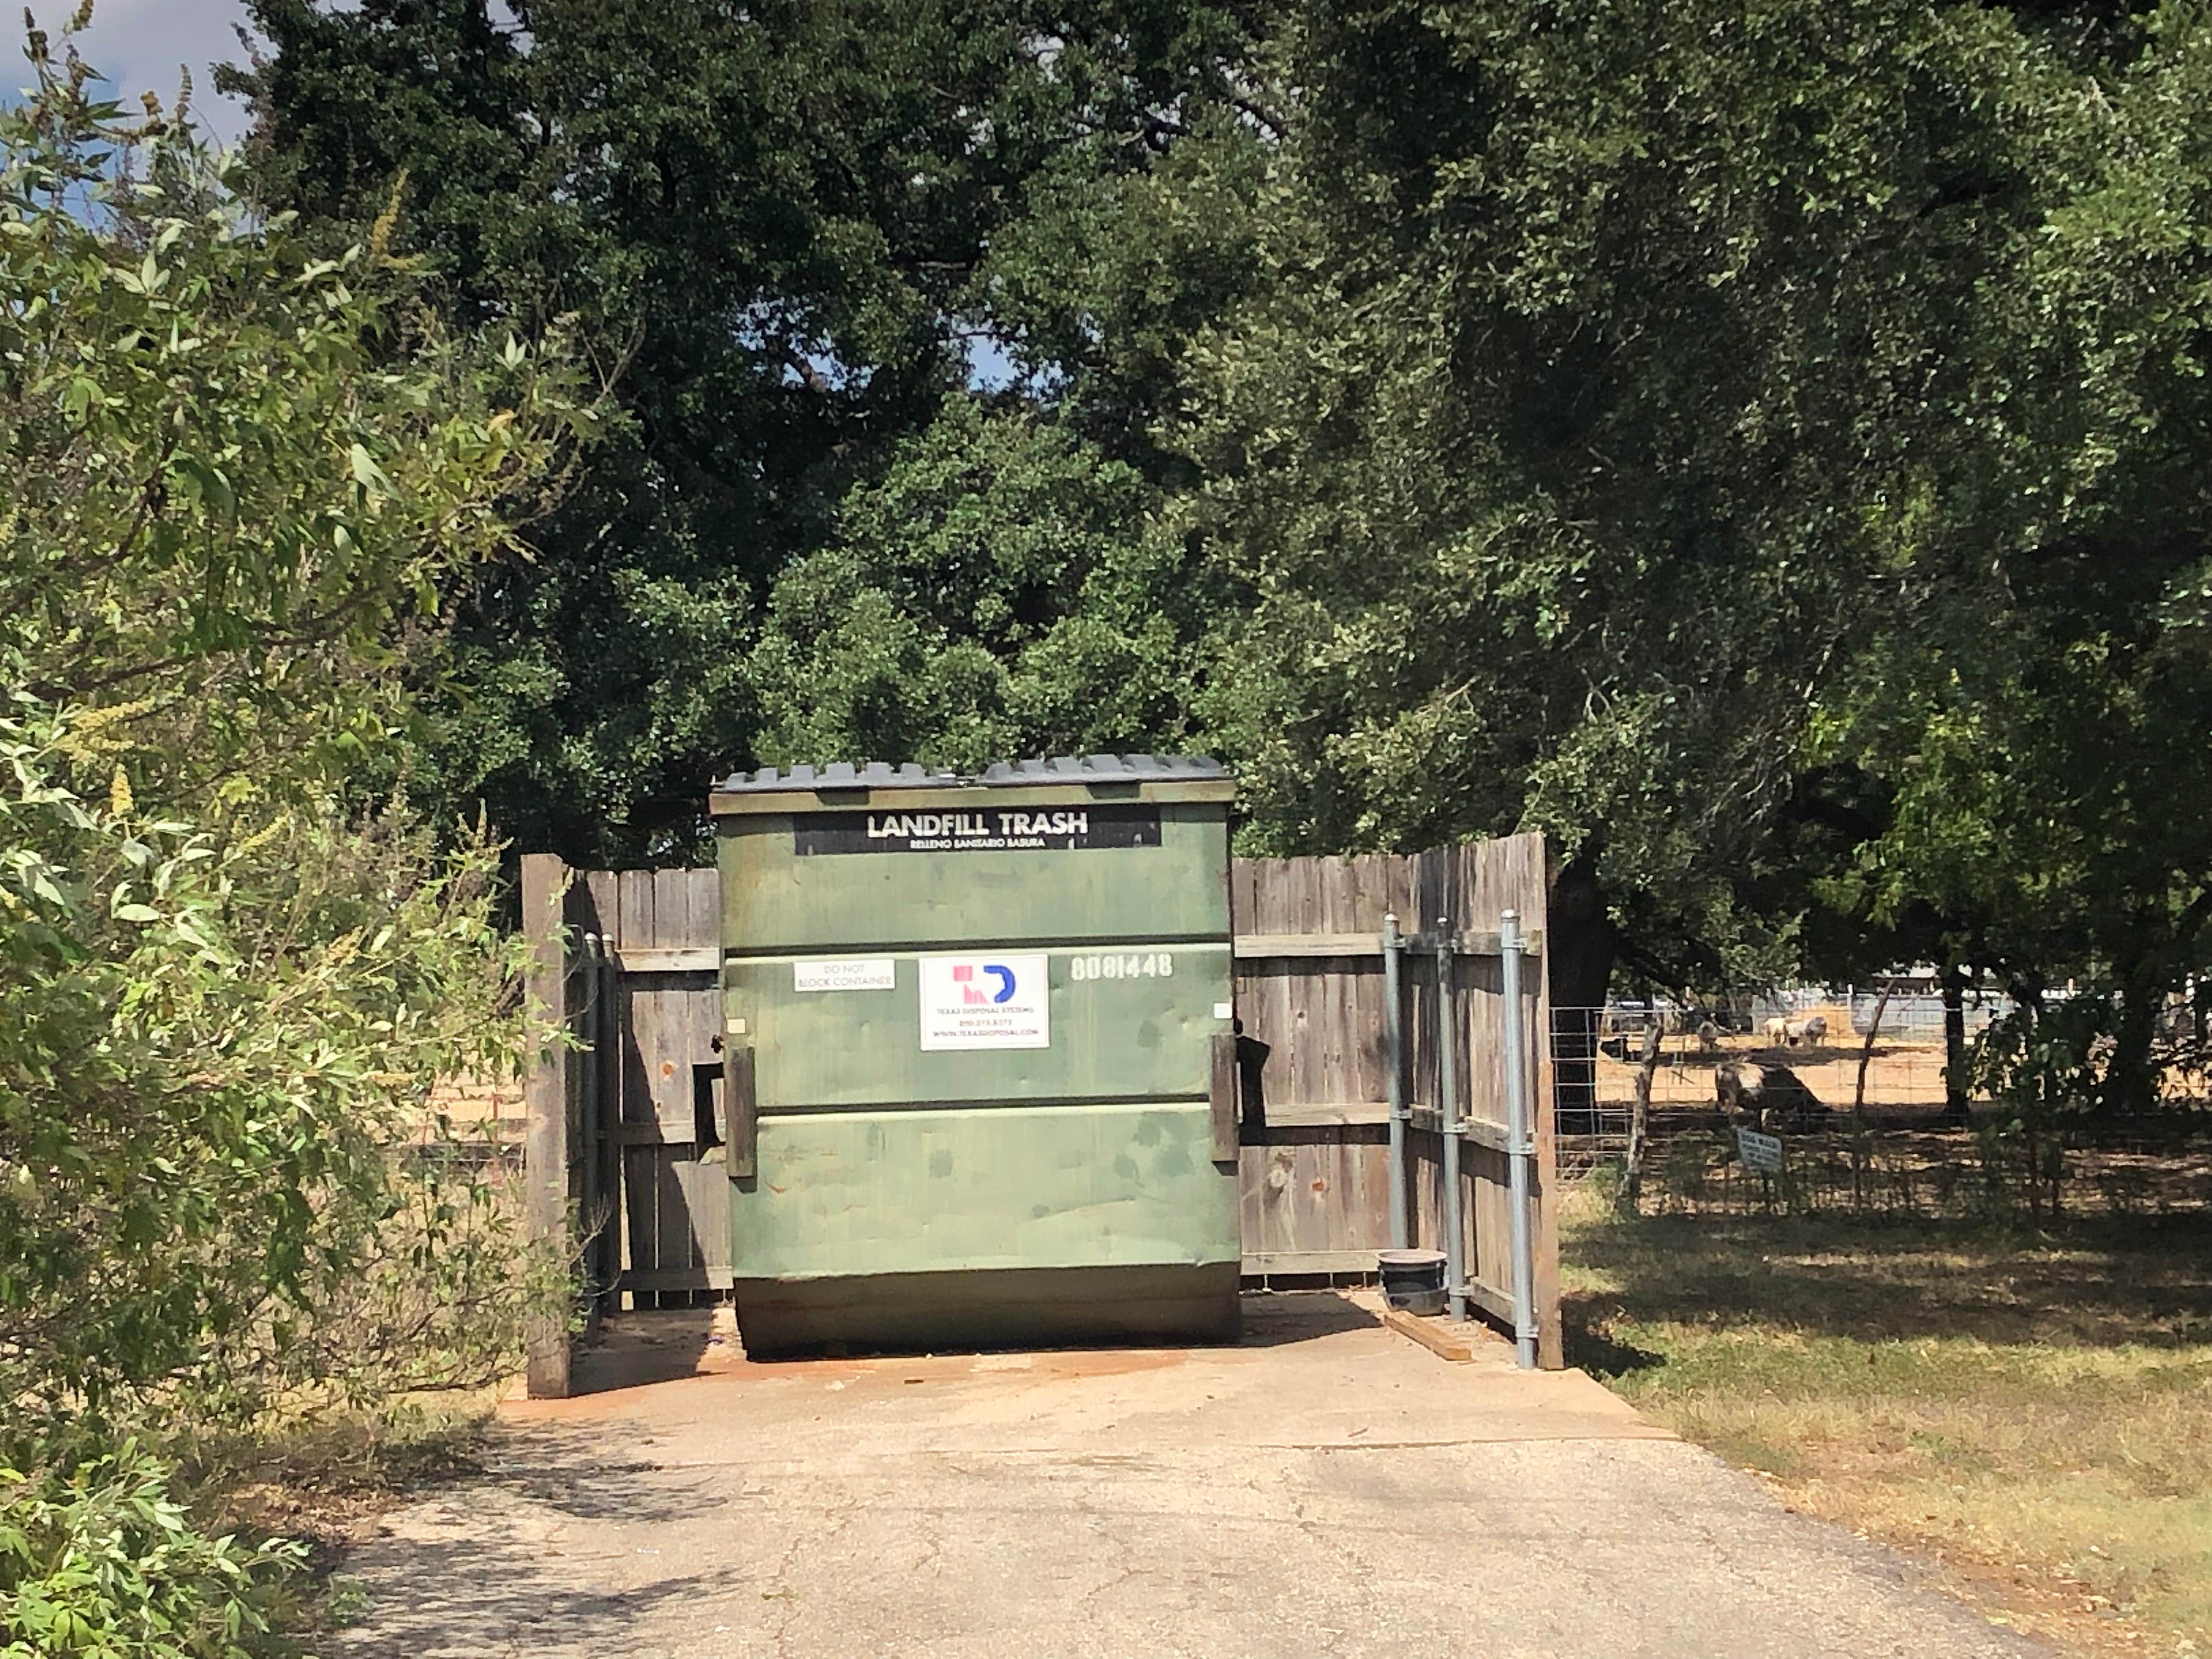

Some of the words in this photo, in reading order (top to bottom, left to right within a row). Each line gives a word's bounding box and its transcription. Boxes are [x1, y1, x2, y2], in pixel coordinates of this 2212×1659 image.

[867, 813, 990, 838] LANDFILL
[998, 812, 1088, 836] TRASH
[910, 838, 951, 849] RELLENO
[954, 838, 1004, 848] SANITARIO
[1007, 837, 1045, 848] BASURA
[824, 964, 840, 974] DO
[843, 964, 865, 973] NOT
[1071, 953, 1173, 981] 8081448
[799, 978, 830, 988] BLOCK
[833, 976, 891, 986] CONTAINER
